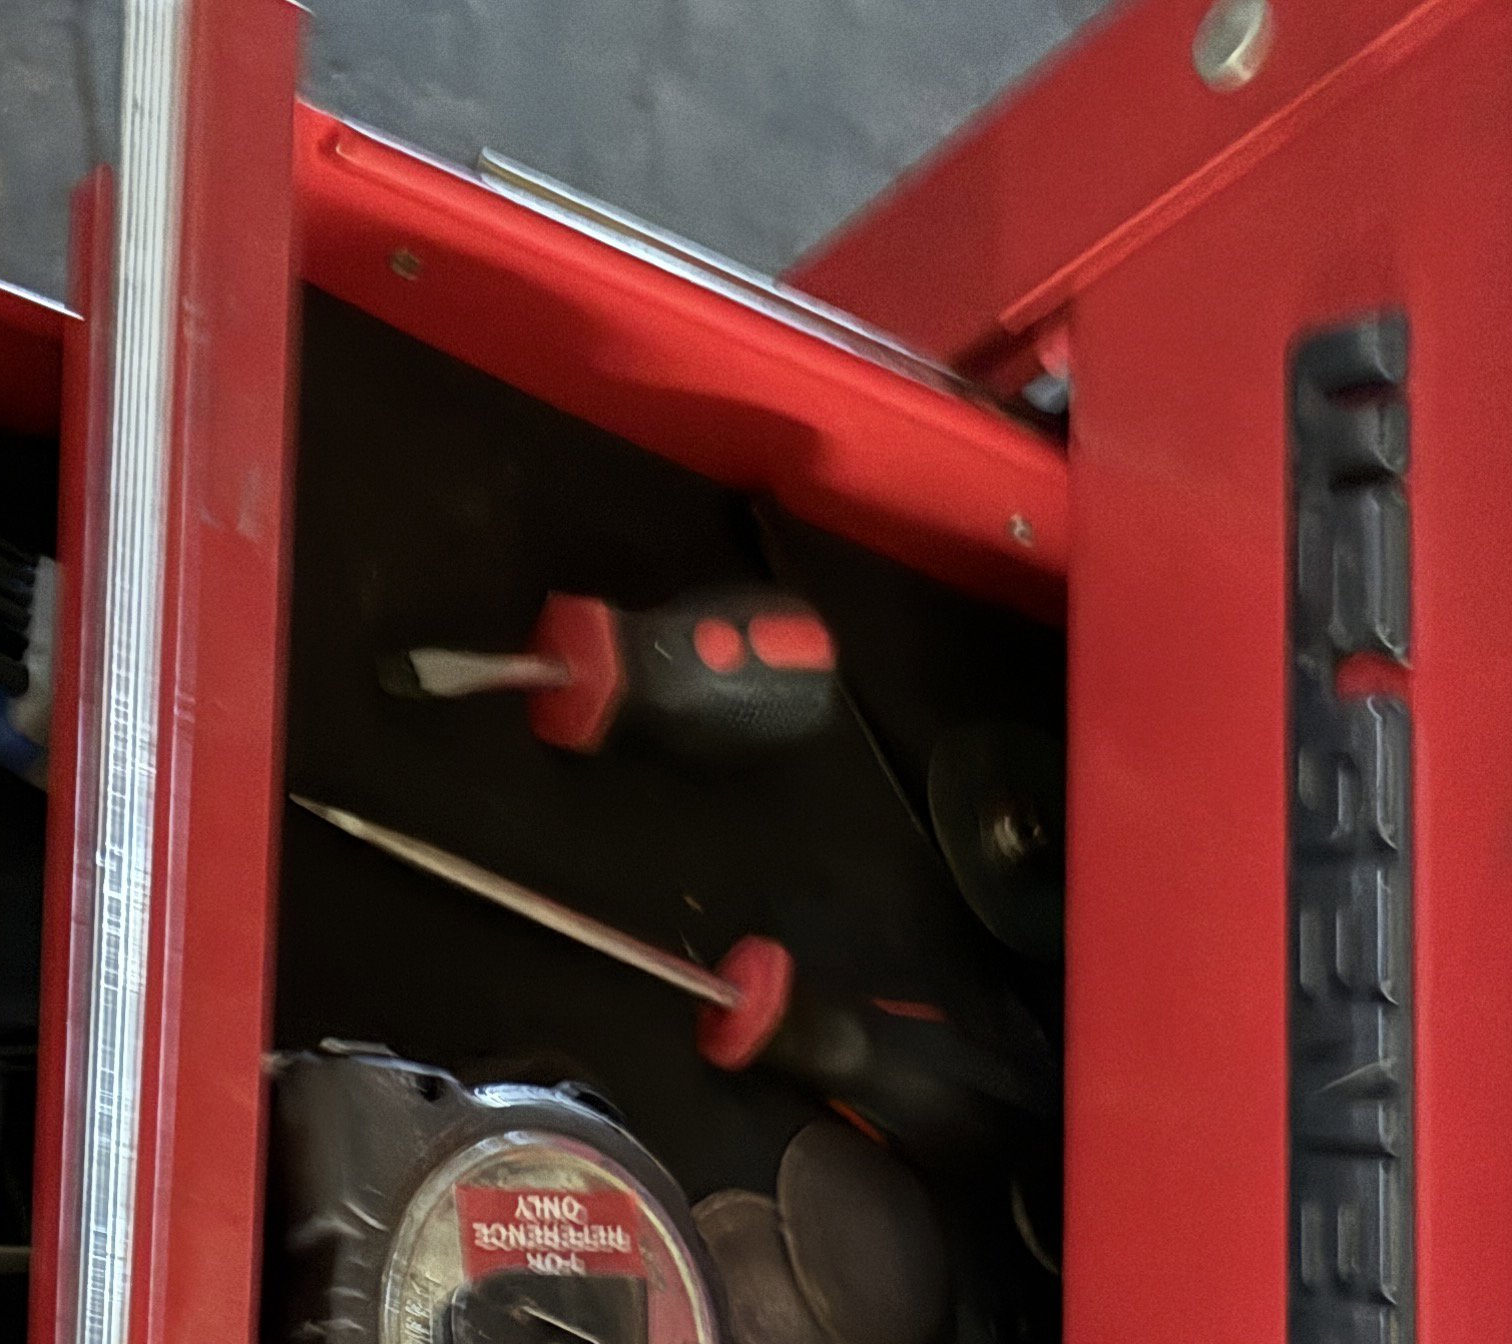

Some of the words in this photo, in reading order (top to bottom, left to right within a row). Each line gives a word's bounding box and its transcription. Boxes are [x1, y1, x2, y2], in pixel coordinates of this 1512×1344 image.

[514, 1193, 588, 1225] ONLY
[472, 1222, 632, 1252] REFERENCE
[526, 1252, 586, 1277] FOR
